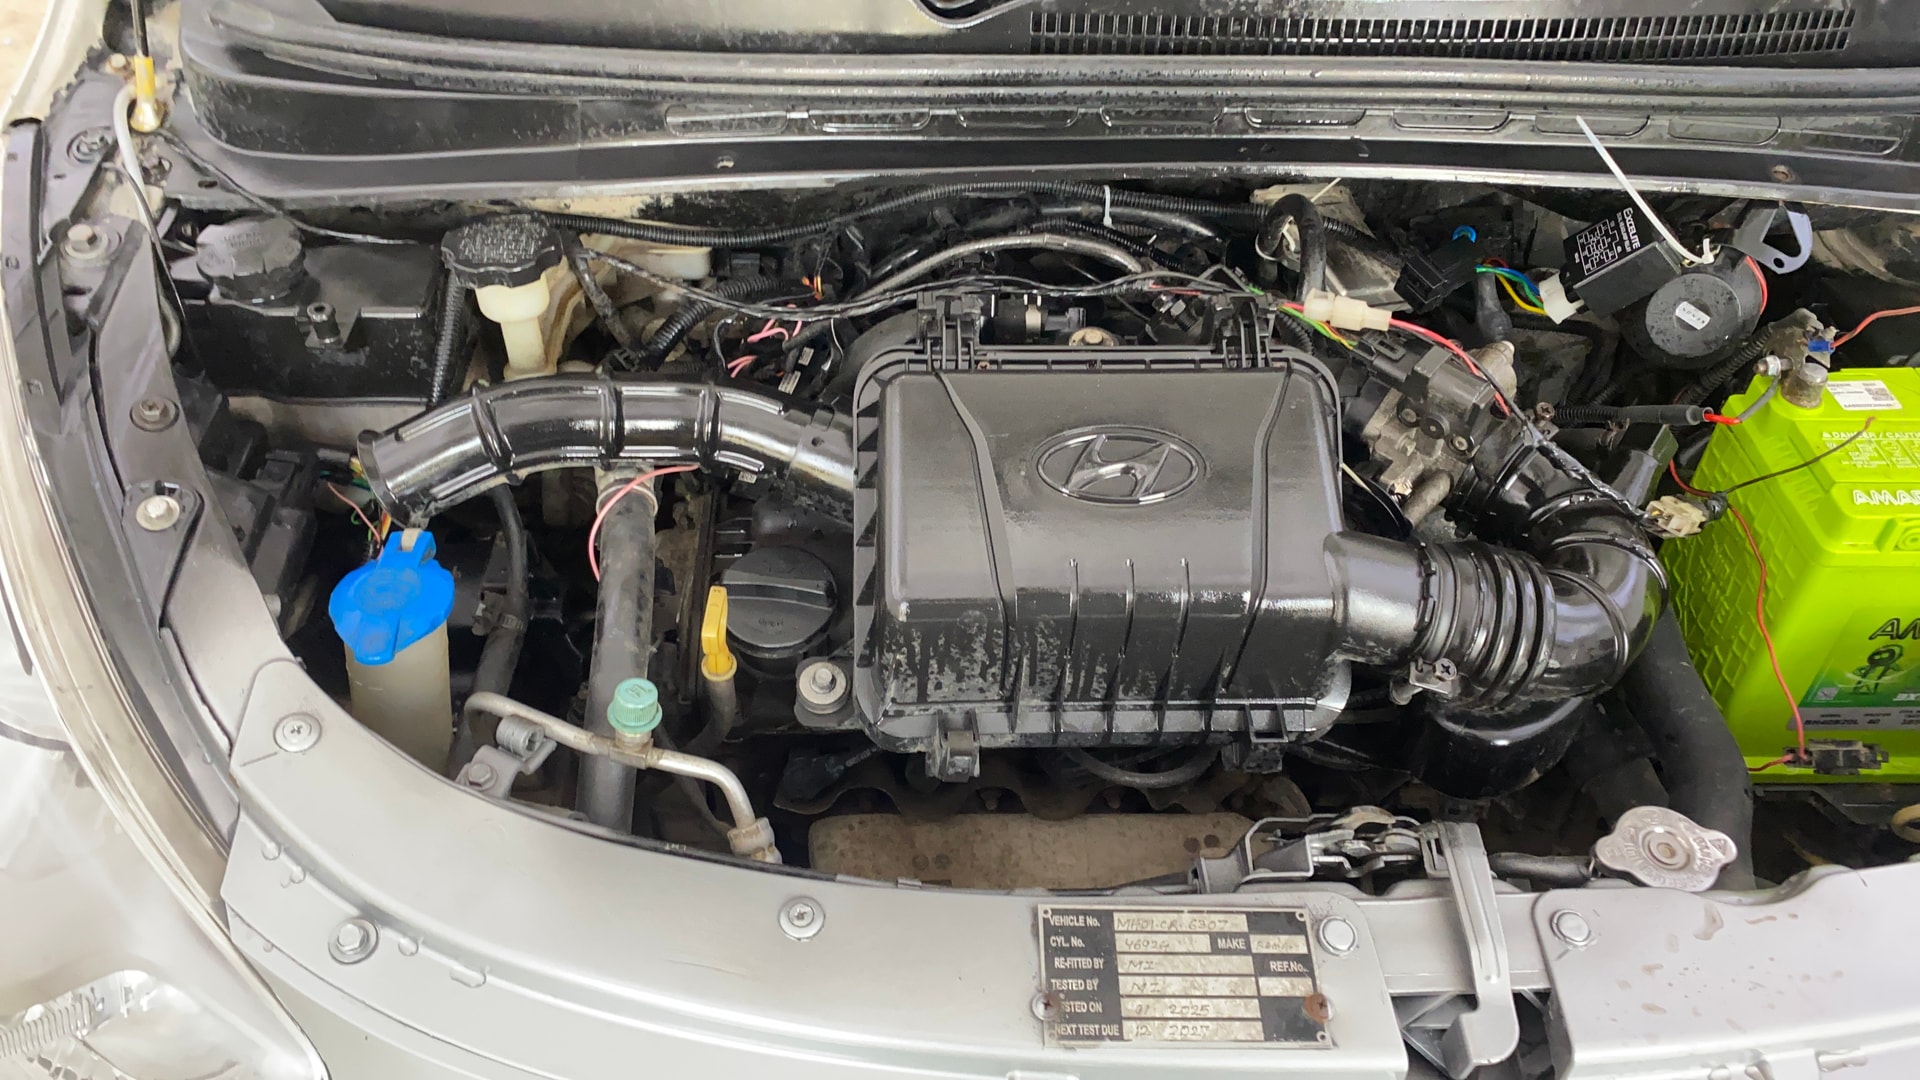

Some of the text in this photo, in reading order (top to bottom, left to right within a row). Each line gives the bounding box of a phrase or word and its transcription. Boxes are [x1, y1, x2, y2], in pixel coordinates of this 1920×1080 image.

[1049, 915, 1100, 928] VEHICLE No.
[1050, 936, 1085, 948] CYL. No.
[1217, 937, 1247, 950] MAKE
[1054, 957, 1104, 970] RE-FITTED BY
[1051, 979, 1099, 991] TESTED BY
[1057, 1001, 1103, 1013] STED ON
[1168, 1003, 1210, 1016] 2025
[1055, 1023, 1119, 1036] NEXT TEST DUE
